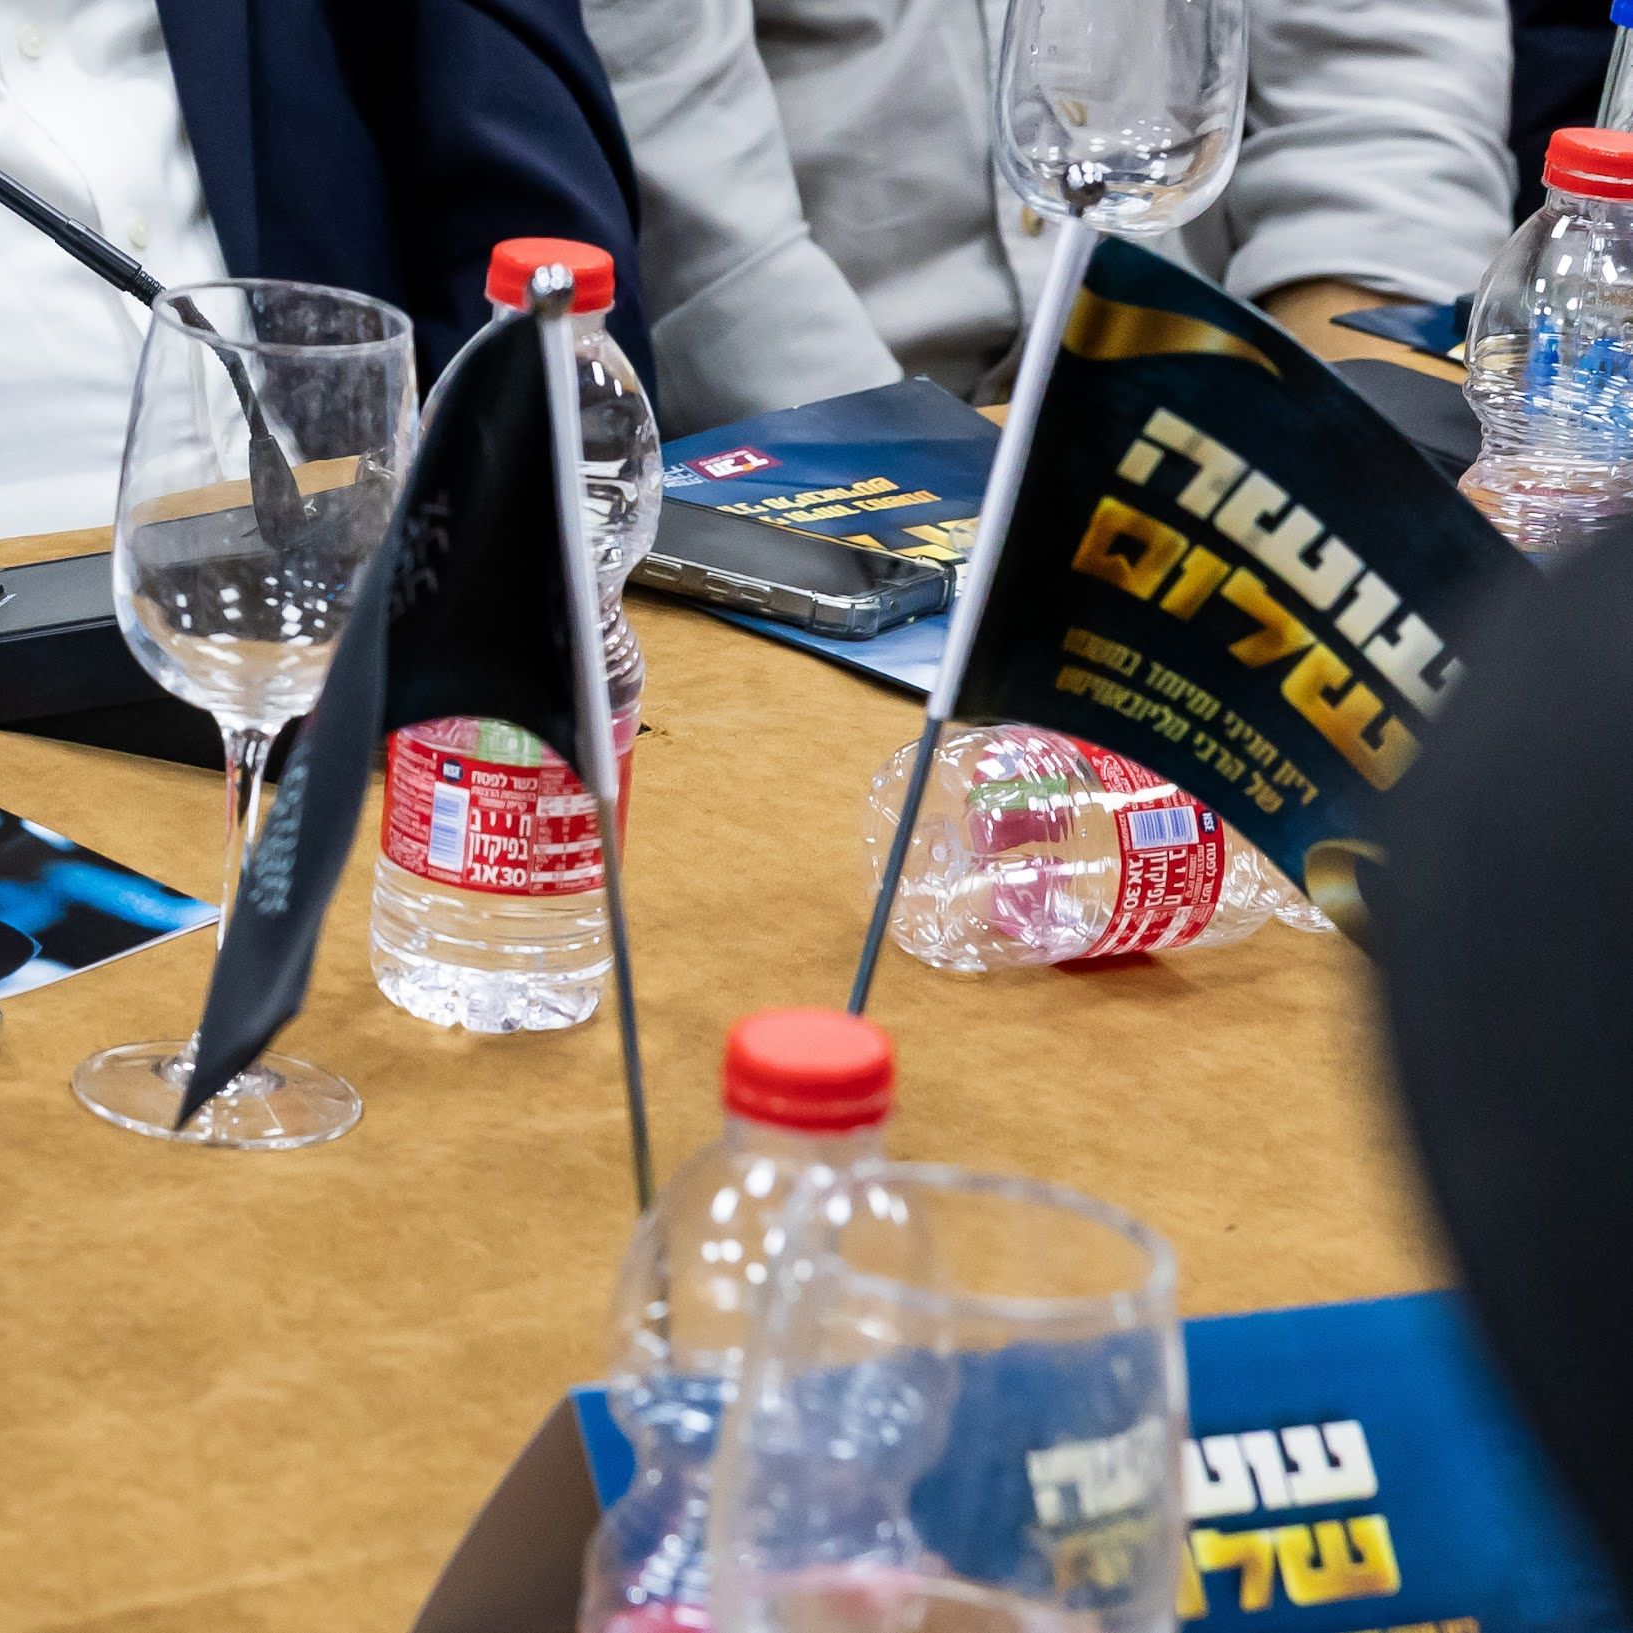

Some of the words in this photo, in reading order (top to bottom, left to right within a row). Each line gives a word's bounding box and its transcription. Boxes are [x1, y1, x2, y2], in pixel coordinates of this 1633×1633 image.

[1071, 496, 1423, 791] שלום
[471, 770, 509, 789] לפסח
[513, 776, 538, 791] כשר
[468, 832, 529, 870] בפיקדון
[1205, 842, 1217, 876] לפסח
[1138, 850, 1169, 907] בפיקדון
[1199, 877, 1214, 903] כשר
